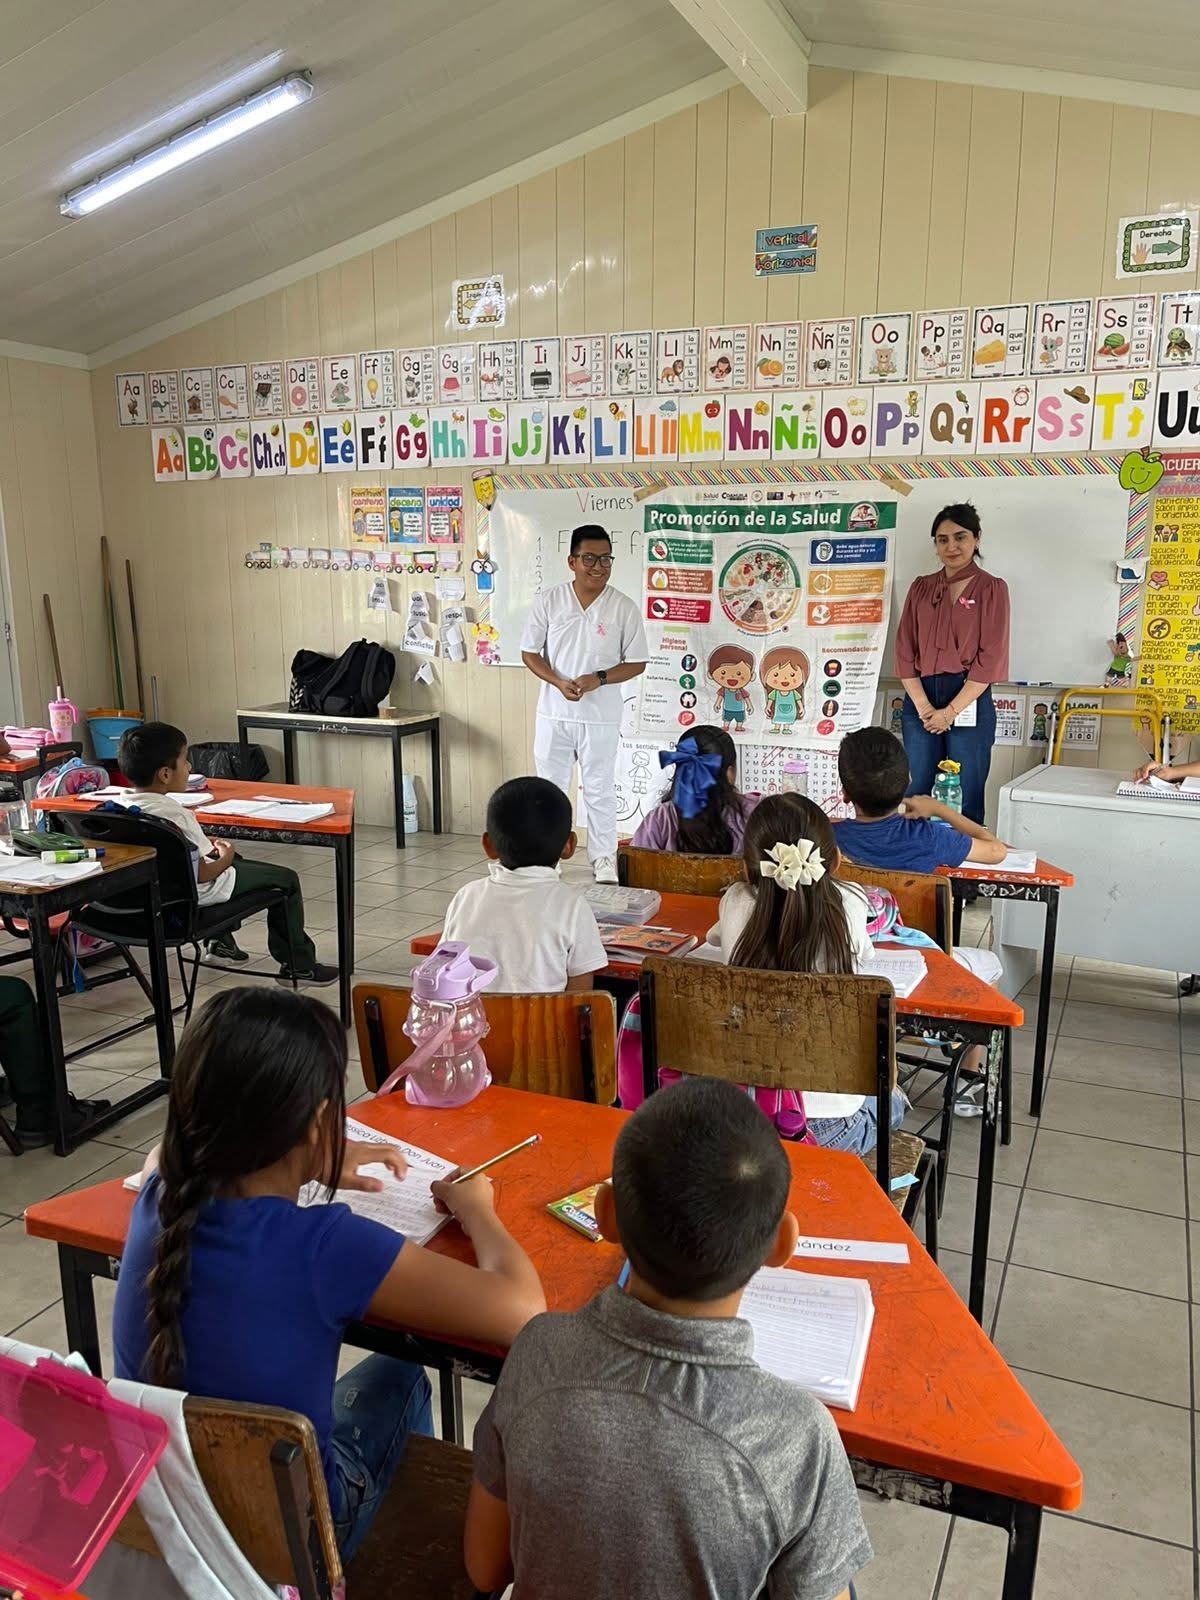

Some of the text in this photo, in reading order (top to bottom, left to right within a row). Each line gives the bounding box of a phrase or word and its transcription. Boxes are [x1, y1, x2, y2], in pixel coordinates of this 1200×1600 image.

[765, 231, 809, 246] vertical
[1140, 229, 1172, 239] Derecha
[756, 254, 815, 270] horizontal
[953, 315, 963, 323] pa
[1041, 313, 1065, 333] Rr
[1104, 308, 1128, 328] Ss
[1171, 304, 1193, 324] Tt
[872, 323, 899, 344] Oo
[923, 320, 945, 343] Pp
[952, 328, 962, 336] pe
[980, 315, 1004, 336] Qq
[1009, 331, 1023, 340] que
[709, 335, 733, 349] Mm
[760, 334, 781, 351] Nn
[812, 327, 834, 351] Ññ
[953, 341, 960, 349] pi
[1009, 344, 1021, 353] qui
[483, 351, 500, 367] Hh
[534, 345, 546, 364] Ii
[572, 345, 586, 366] Jj
[615, 342, 633, 359] Kk
[331, 362, 348, 380] Ee
[364, 358, 378, 375] Ff
[402, 356, 420, 376] Gg
[442, 354, 458, 373] Gg
[186, 377, 200, 391] Cc
[220, 375, 234, 389] Cc
[290, 368, 306, 383] Dd
[124, 380, 140, 396] Aa
[152, 380, 166, 394] Bb
[876, 402, 919, 446] Pp
[930, 402, 974, 444] Qq
[983, 398, 1031, 443] Rr
[1037, 396, 1084, 441] Ss
[1095, 392, 1144, 440] Tt
[512, 418, 542, 457] Jj
[553, 415, 586, 455] Kk
[680, 411, 721, 453] Mm
[728, 408, 769, 451] Nn
[775, 404, 817, 451] Ññ
[824, 407, 866, 448] Oo
[323, 428, 354, 464] Ee
[362, 427, 387, 464] Ff
[396, 425, 428, 460] Gg
[432, 420, 466, 458] Hh
[473, 419, 502, 458] Ii
[156, 439, 184, 474] Aa
[187, 437, 218, 472] Bb
[219, 436, 249, 470] Cc
[289, 432, 318, 468] Dd
[390, 498, 422, 506] decena
[429, 497, 460, 507] unidad
[577, 491, 634, 512] Viernes
[650, 509, 841, 526] Promoción de la Salud
[537, 537, 542, 552] 1
[557, 530, 570, 553] F
[536, 555, 543, 568] 2
[535, 571, 543, 585] 3
[405, 640, 434, 650] conflictos
[662, 637, 687, 645] Higiene
[1051, 702, 1098, 713] cntena
